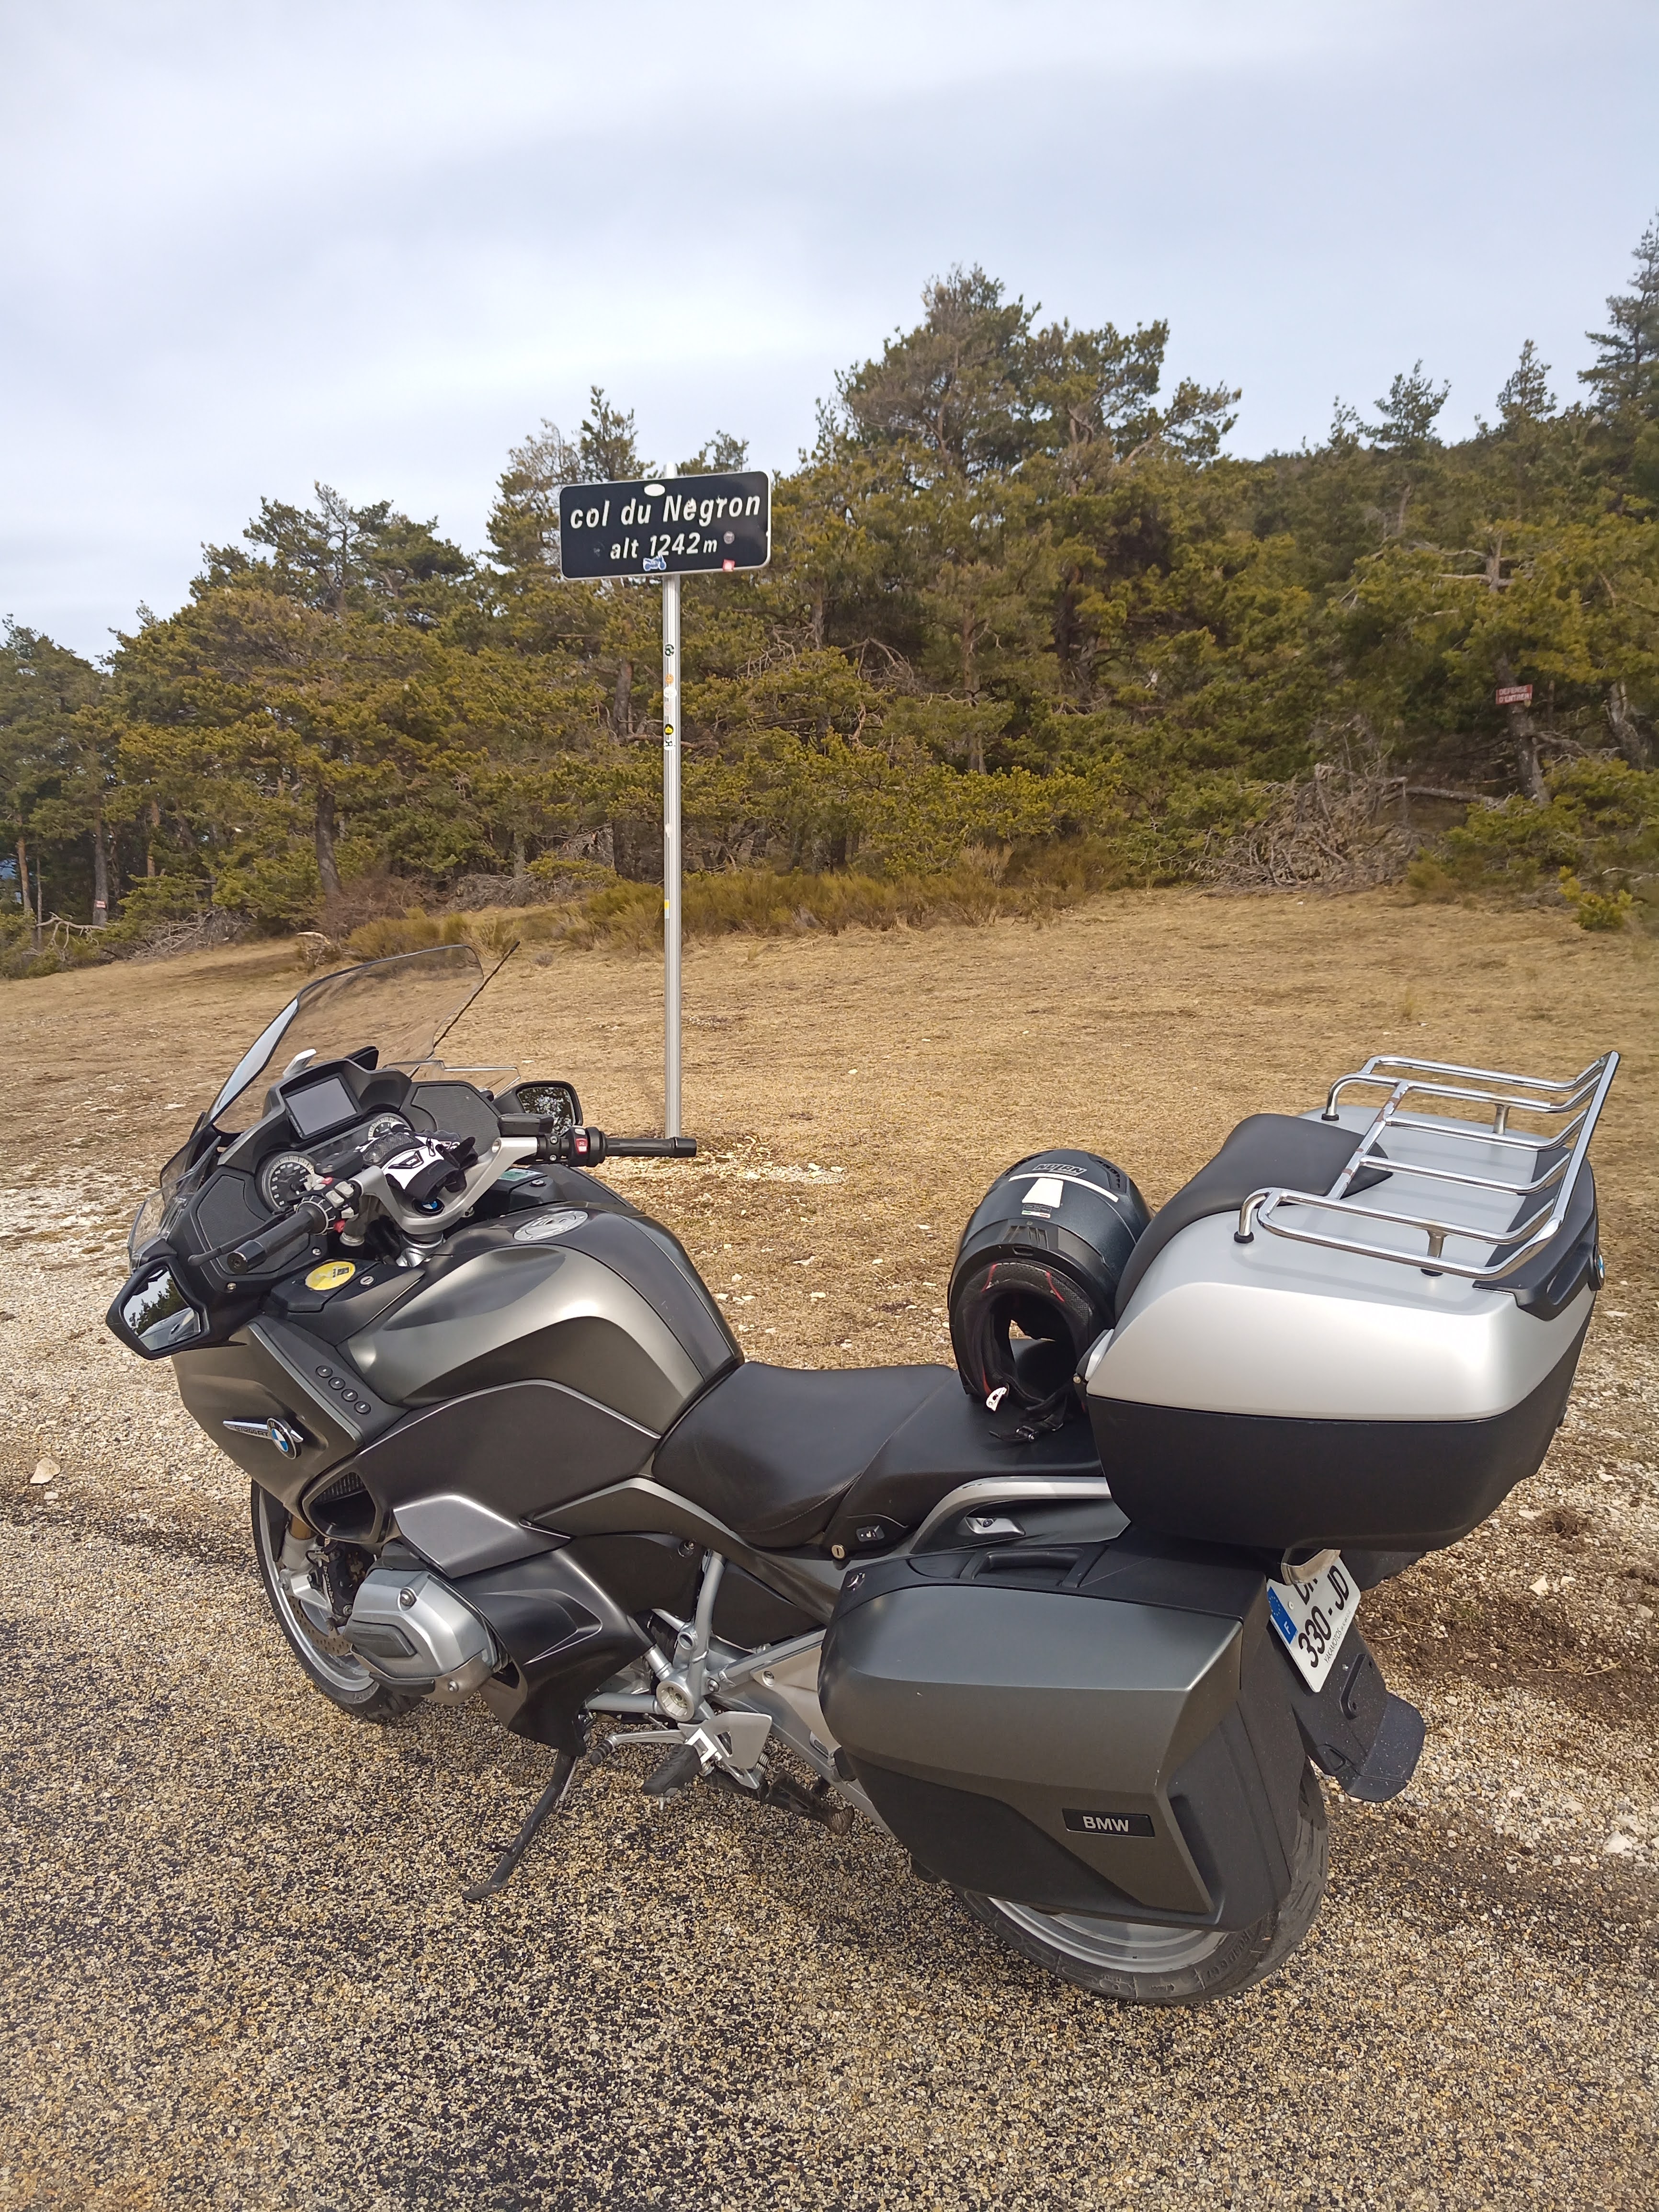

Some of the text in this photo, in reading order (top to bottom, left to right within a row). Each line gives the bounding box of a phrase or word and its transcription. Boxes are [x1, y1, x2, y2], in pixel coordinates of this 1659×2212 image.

[570, 494, 760, 529] col du Negron
[610, 536, 639, 559] alt
[1034, 1164, 1085, 1174] NOLAN
[323, 1566, 334, 1604] brembo
[1284, 1621, 1291, 1635] F
[1083, 1816, 1128, 1832] BMW
